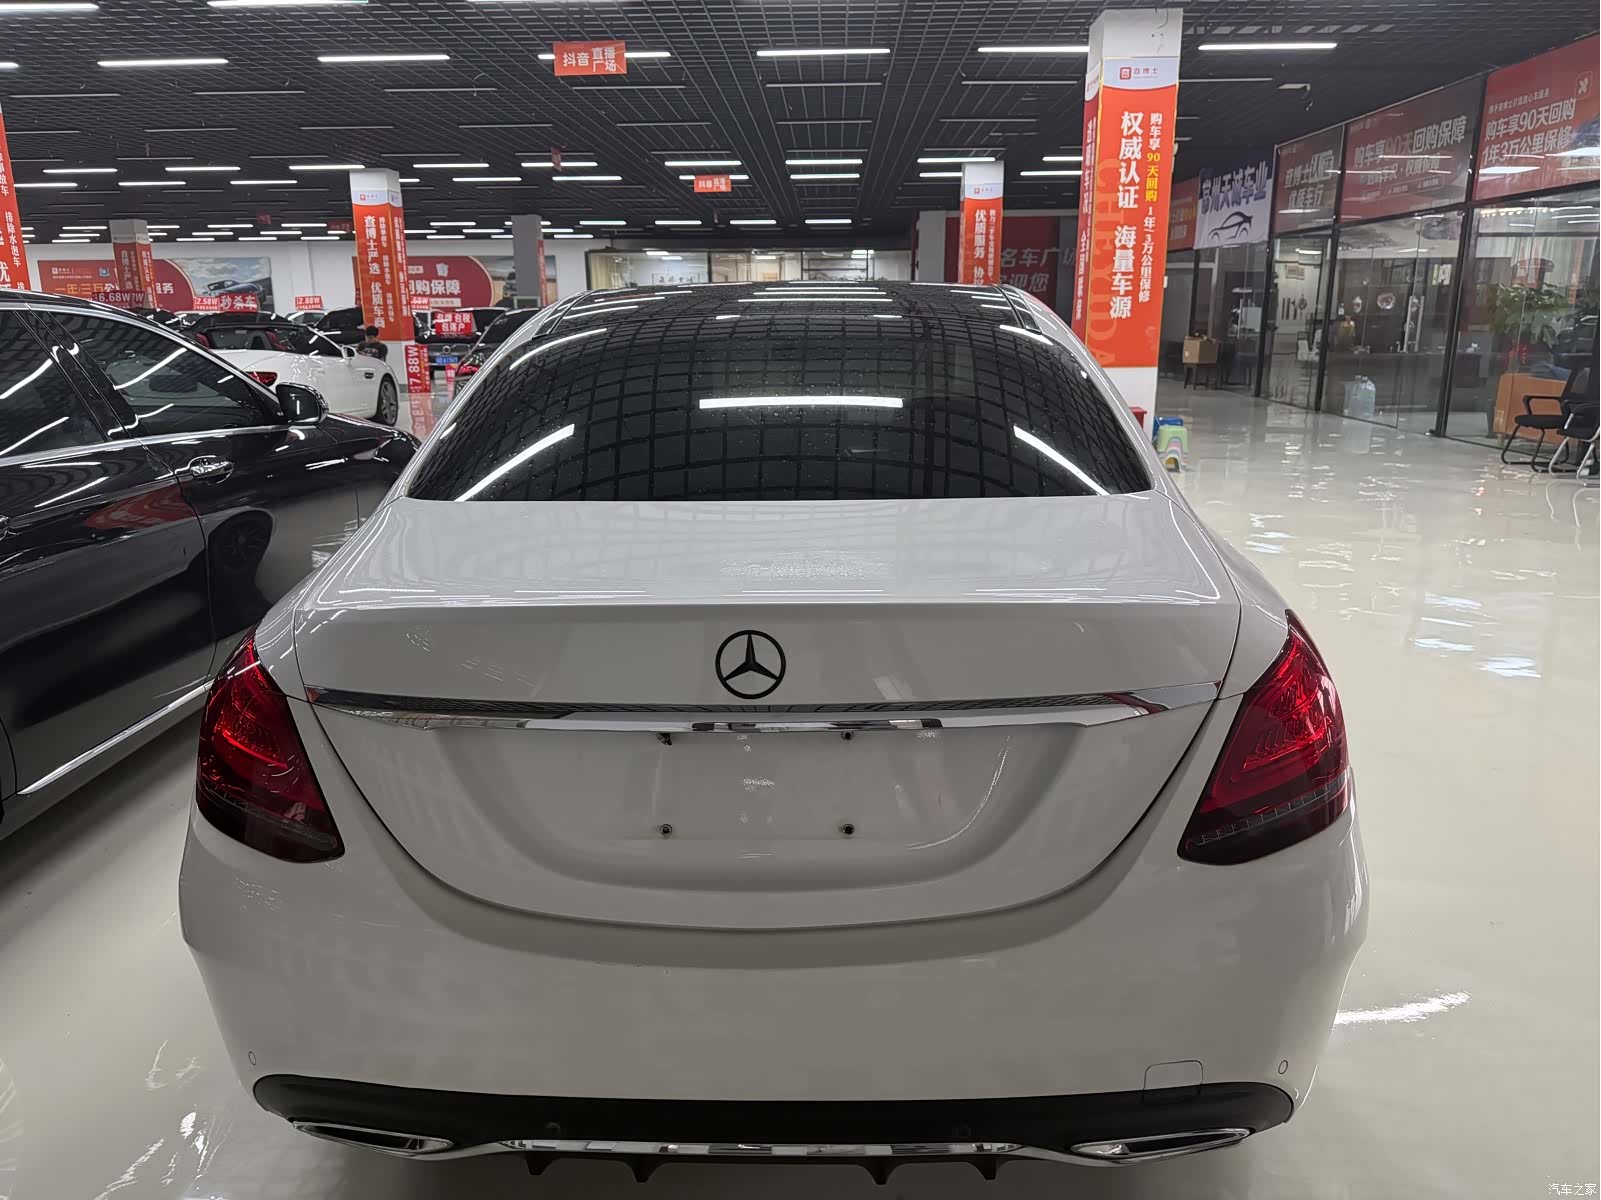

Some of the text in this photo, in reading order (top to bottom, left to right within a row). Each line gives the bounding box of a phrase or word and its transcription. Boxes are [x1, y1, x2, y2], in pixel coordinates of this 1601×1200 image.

[563, 52, 589, 67] 抖音
[592, 47, 615, 60] 直播
[593, 60, 616, 72] 广场
[1485, 98, 1576, 141] 购车享90天回购
[1483, 126, 1573, 165] 1年3万公里保修
[973, 209, 986, 259] 优质服务
[1110, 111, 1144, 320] 权威认证 海量车源
[363, 215, 381, 275] 查博士严选
[98, 292, 131, 303] 6.68W
[221, 295, 257, 310] 秒杀车
[371, 282, 385, 329] 优质车商
[408, 346, 421, 383] 7.88W
